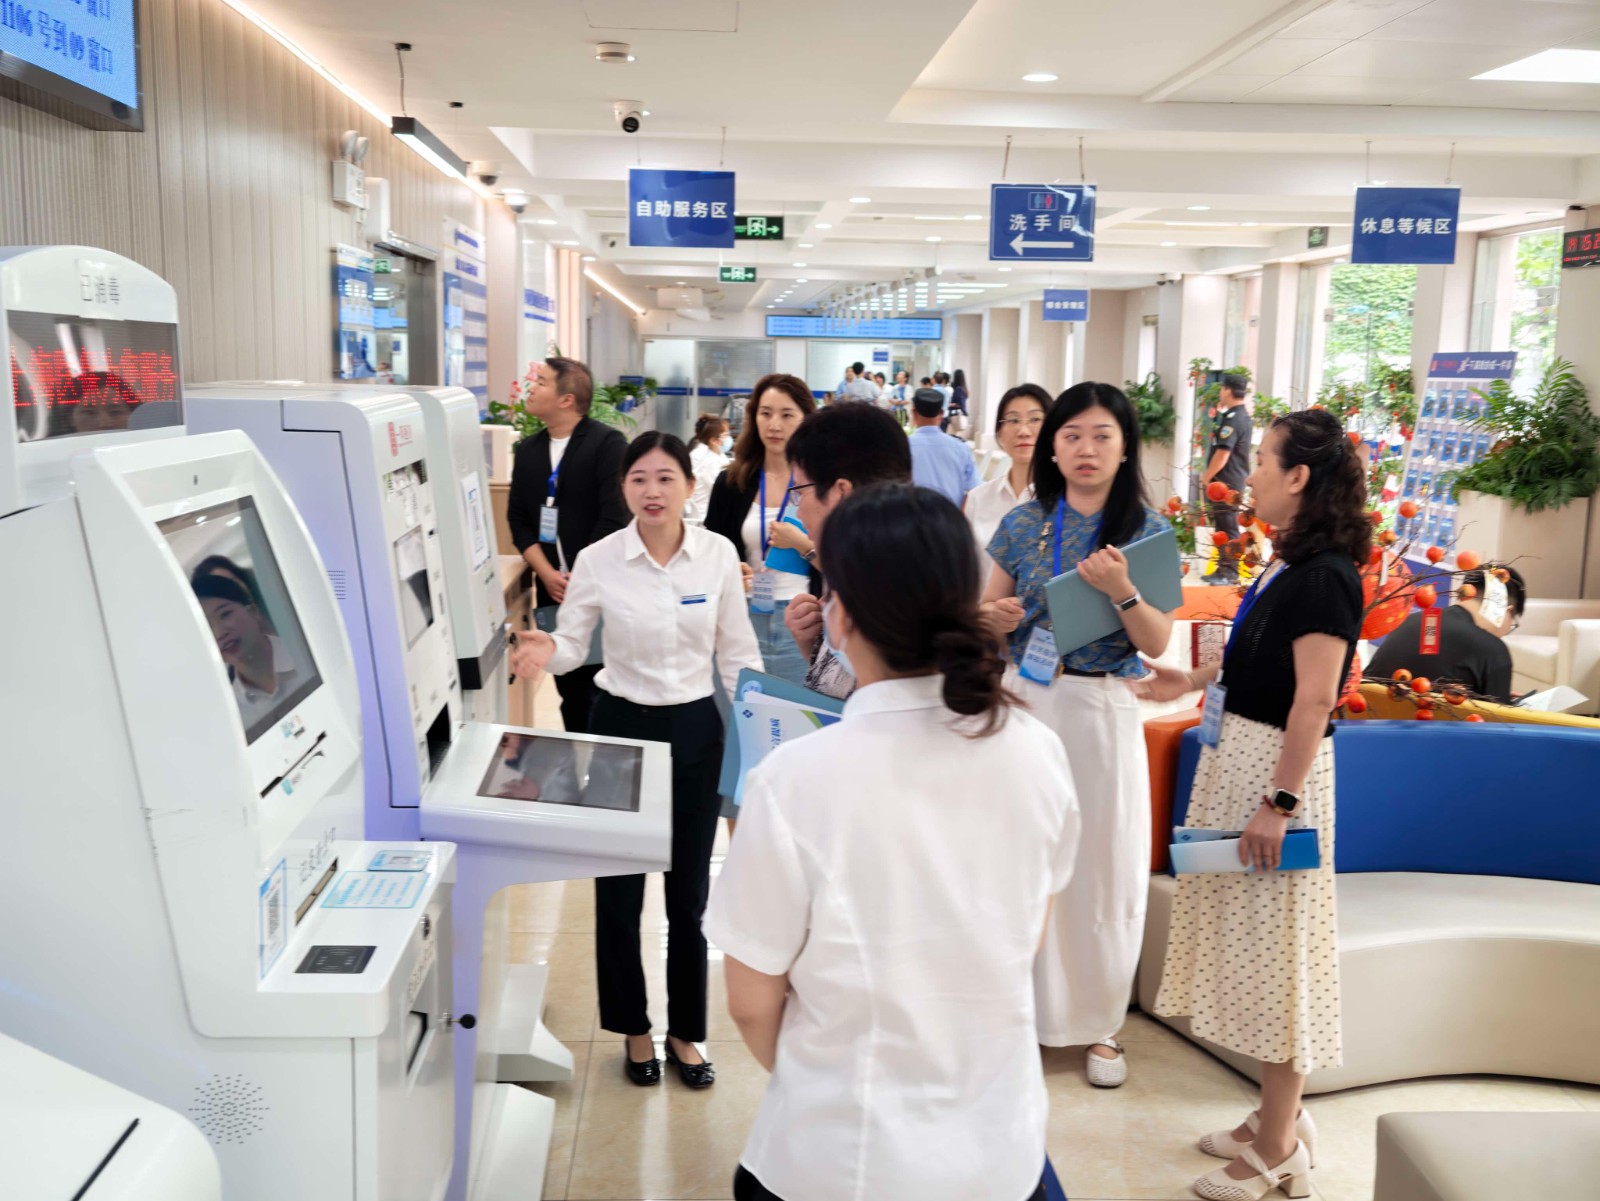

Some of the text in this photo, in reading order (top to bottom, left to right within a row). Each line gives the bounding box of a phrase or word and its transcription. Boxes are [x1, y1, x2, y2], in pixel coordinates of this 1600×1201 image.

[636, 200, 728, 219] 自助服务区
[1009, 213, 1076, 232] 洗手间
[1360, 218, 1452, 235] 休息等候区
